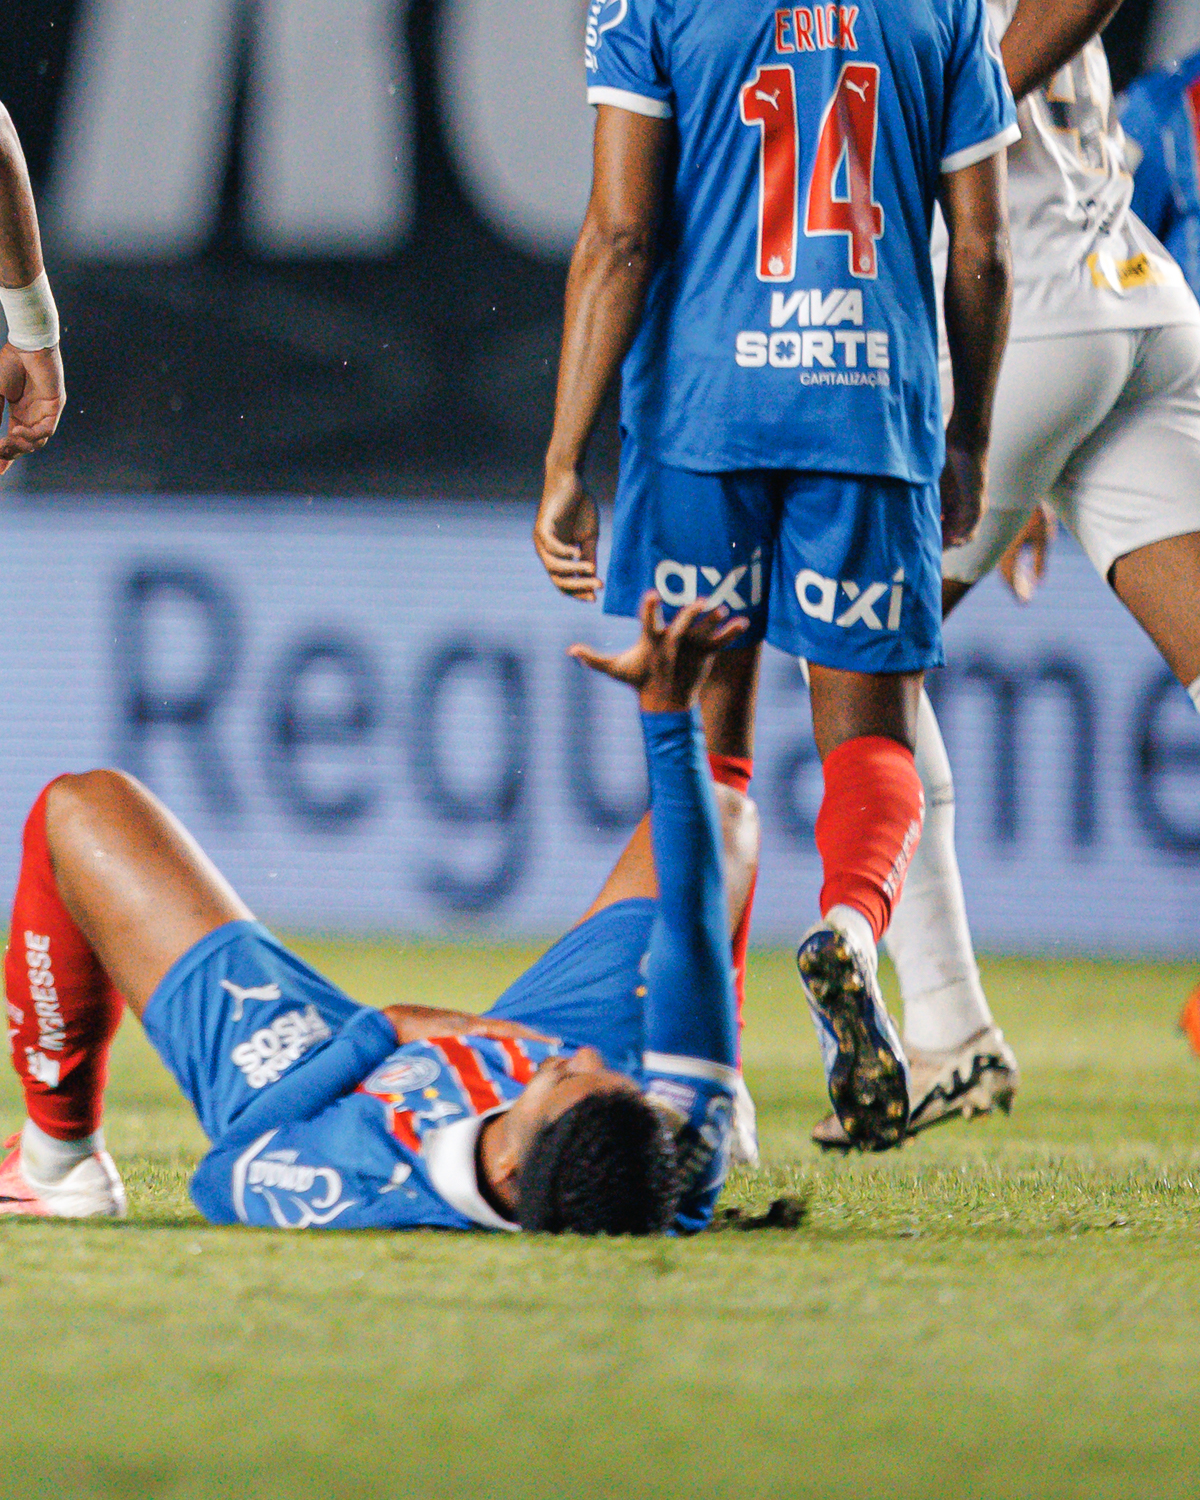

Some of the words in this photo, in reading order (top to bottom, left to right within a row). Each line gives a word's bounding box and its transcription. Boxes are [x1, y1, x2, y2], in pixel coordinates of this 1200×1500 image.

[775, 2, 859, 55] ERICK
[739, 61, 885, 283] 14
[769, 288, 864, 328] VIVA
[735, 329, 891, 369] SORTE
[654, 546, 762, 612] axi
[794, 566, 905, 631] axi
